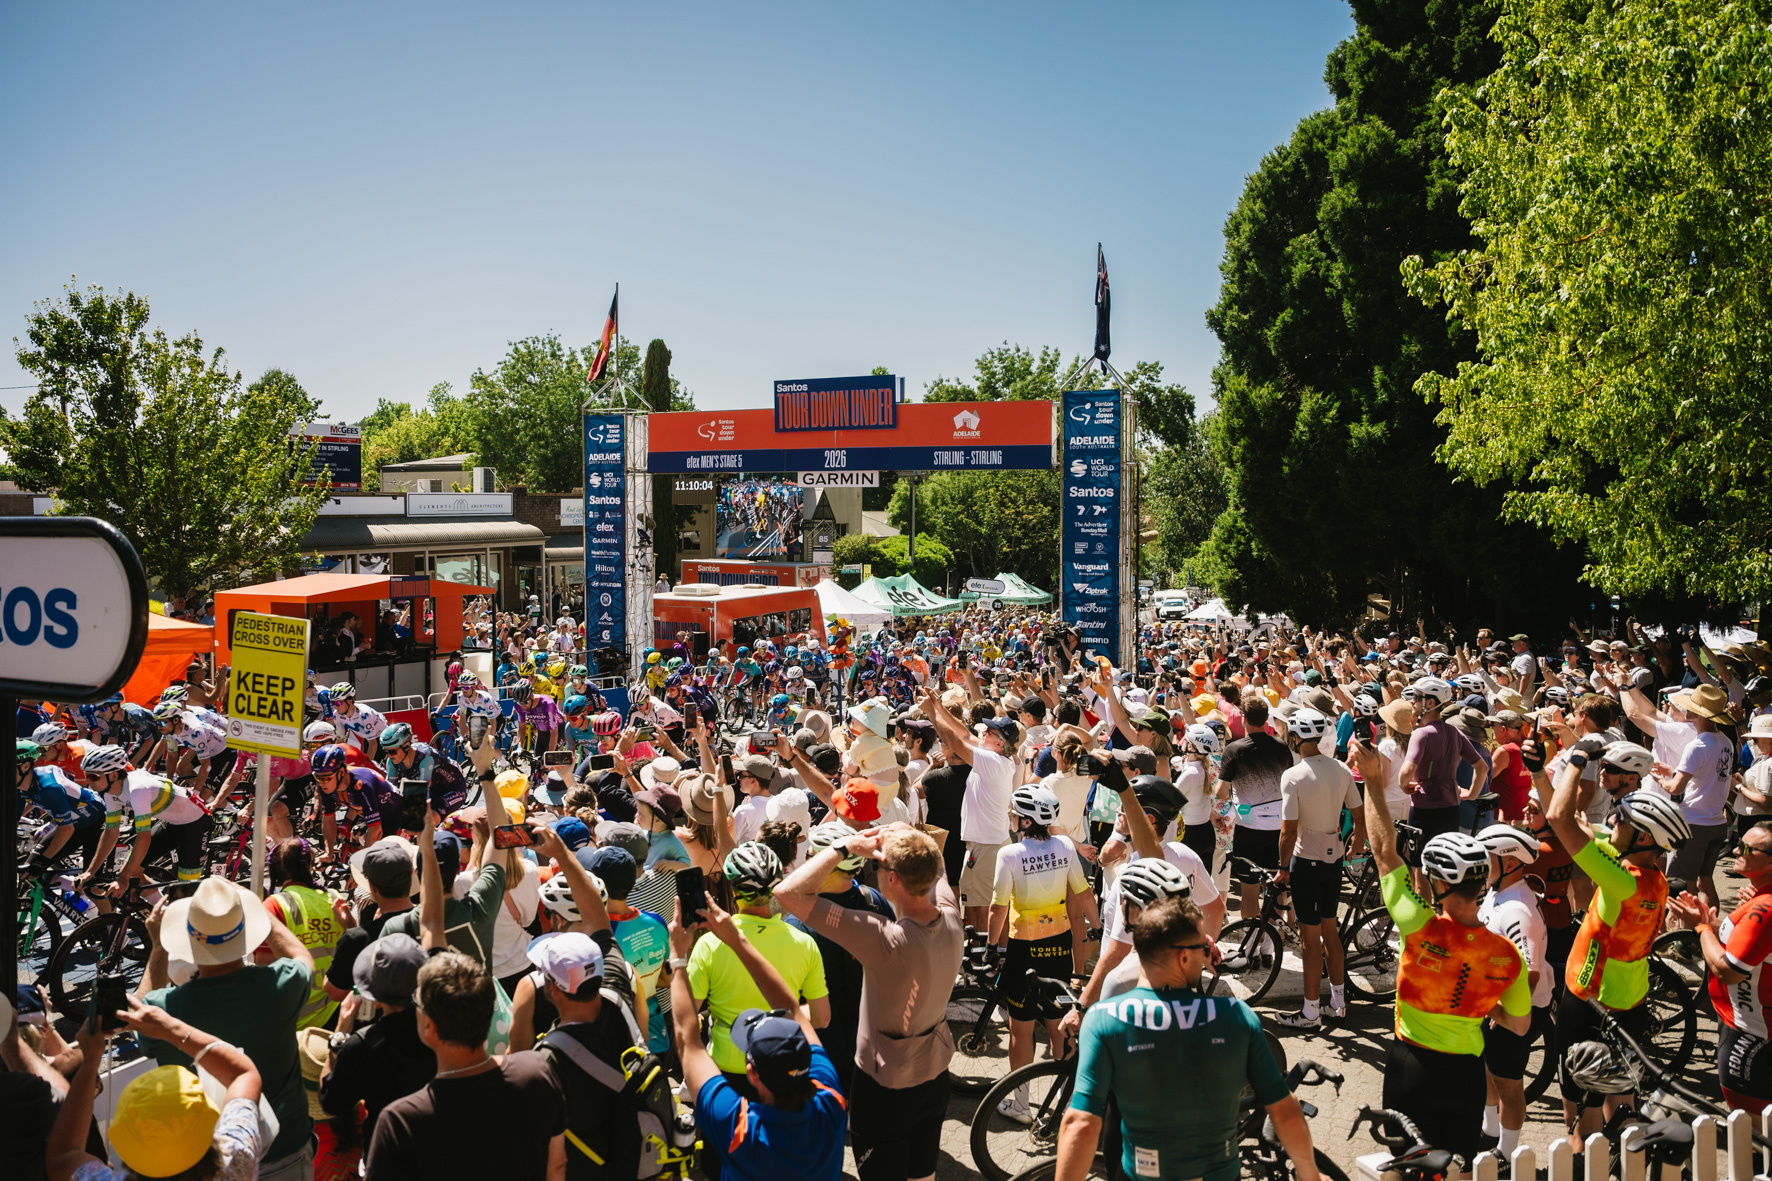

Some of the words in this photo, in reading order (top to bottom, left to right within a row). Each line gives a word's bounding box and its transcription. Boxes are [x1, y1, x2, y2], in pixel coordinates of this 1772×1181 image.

[776, 384, 808, 392] Santos
[777, 392, 809, 430] TOUR
[810, 390, 849, 428] DOWN
[852, 388, 893, 426] UNDER
[330, 426, 358, 434] McGEES
[1070, 436, 1115, 445] ADELAIDE
[686, 456, 700, 468] efex
[720, 454, 737, 468] STAGE
[738, 454, 742, 467] 5
[824, 450, 846, 468] 2026
[934, 451, 964, 466] STIRLING
[971, 450, 1002, 465] STIRLING
[675, 480, 713, 491] 11:10:04
[802, 472, 874, 486] GARMIN
[1069, 486, 1114, 497] Santos
[589, 495, 621, 505] Santos
[596, 522, 614, 532] efex
[1073, 562, 1108, 572] Vanguard
[236, 617, 304, 636] PEDESTRIAN
[234, 630, 270, 646] CROSS
[273, 636, 304, 650] OVER
[237, 670, 295, 698] KEEP
[235, 692, 294, 722] CLEAR
[1195, 736, 1212, 745] KASK
[1033, 799, 1049, 808] KASK
[1021, 852, 1056, 864] HONES
[1023, 858, 1068, 872] LAWYERS
[53, 898, 70, 916] VAN
[1587, 940, 1598, 966] BLACK
[1580, 964, 1592, 986] SHEEP
[902, 978, 920, 1032] MAAP
[1728, 1034, 1756, 1078] REDLAND
